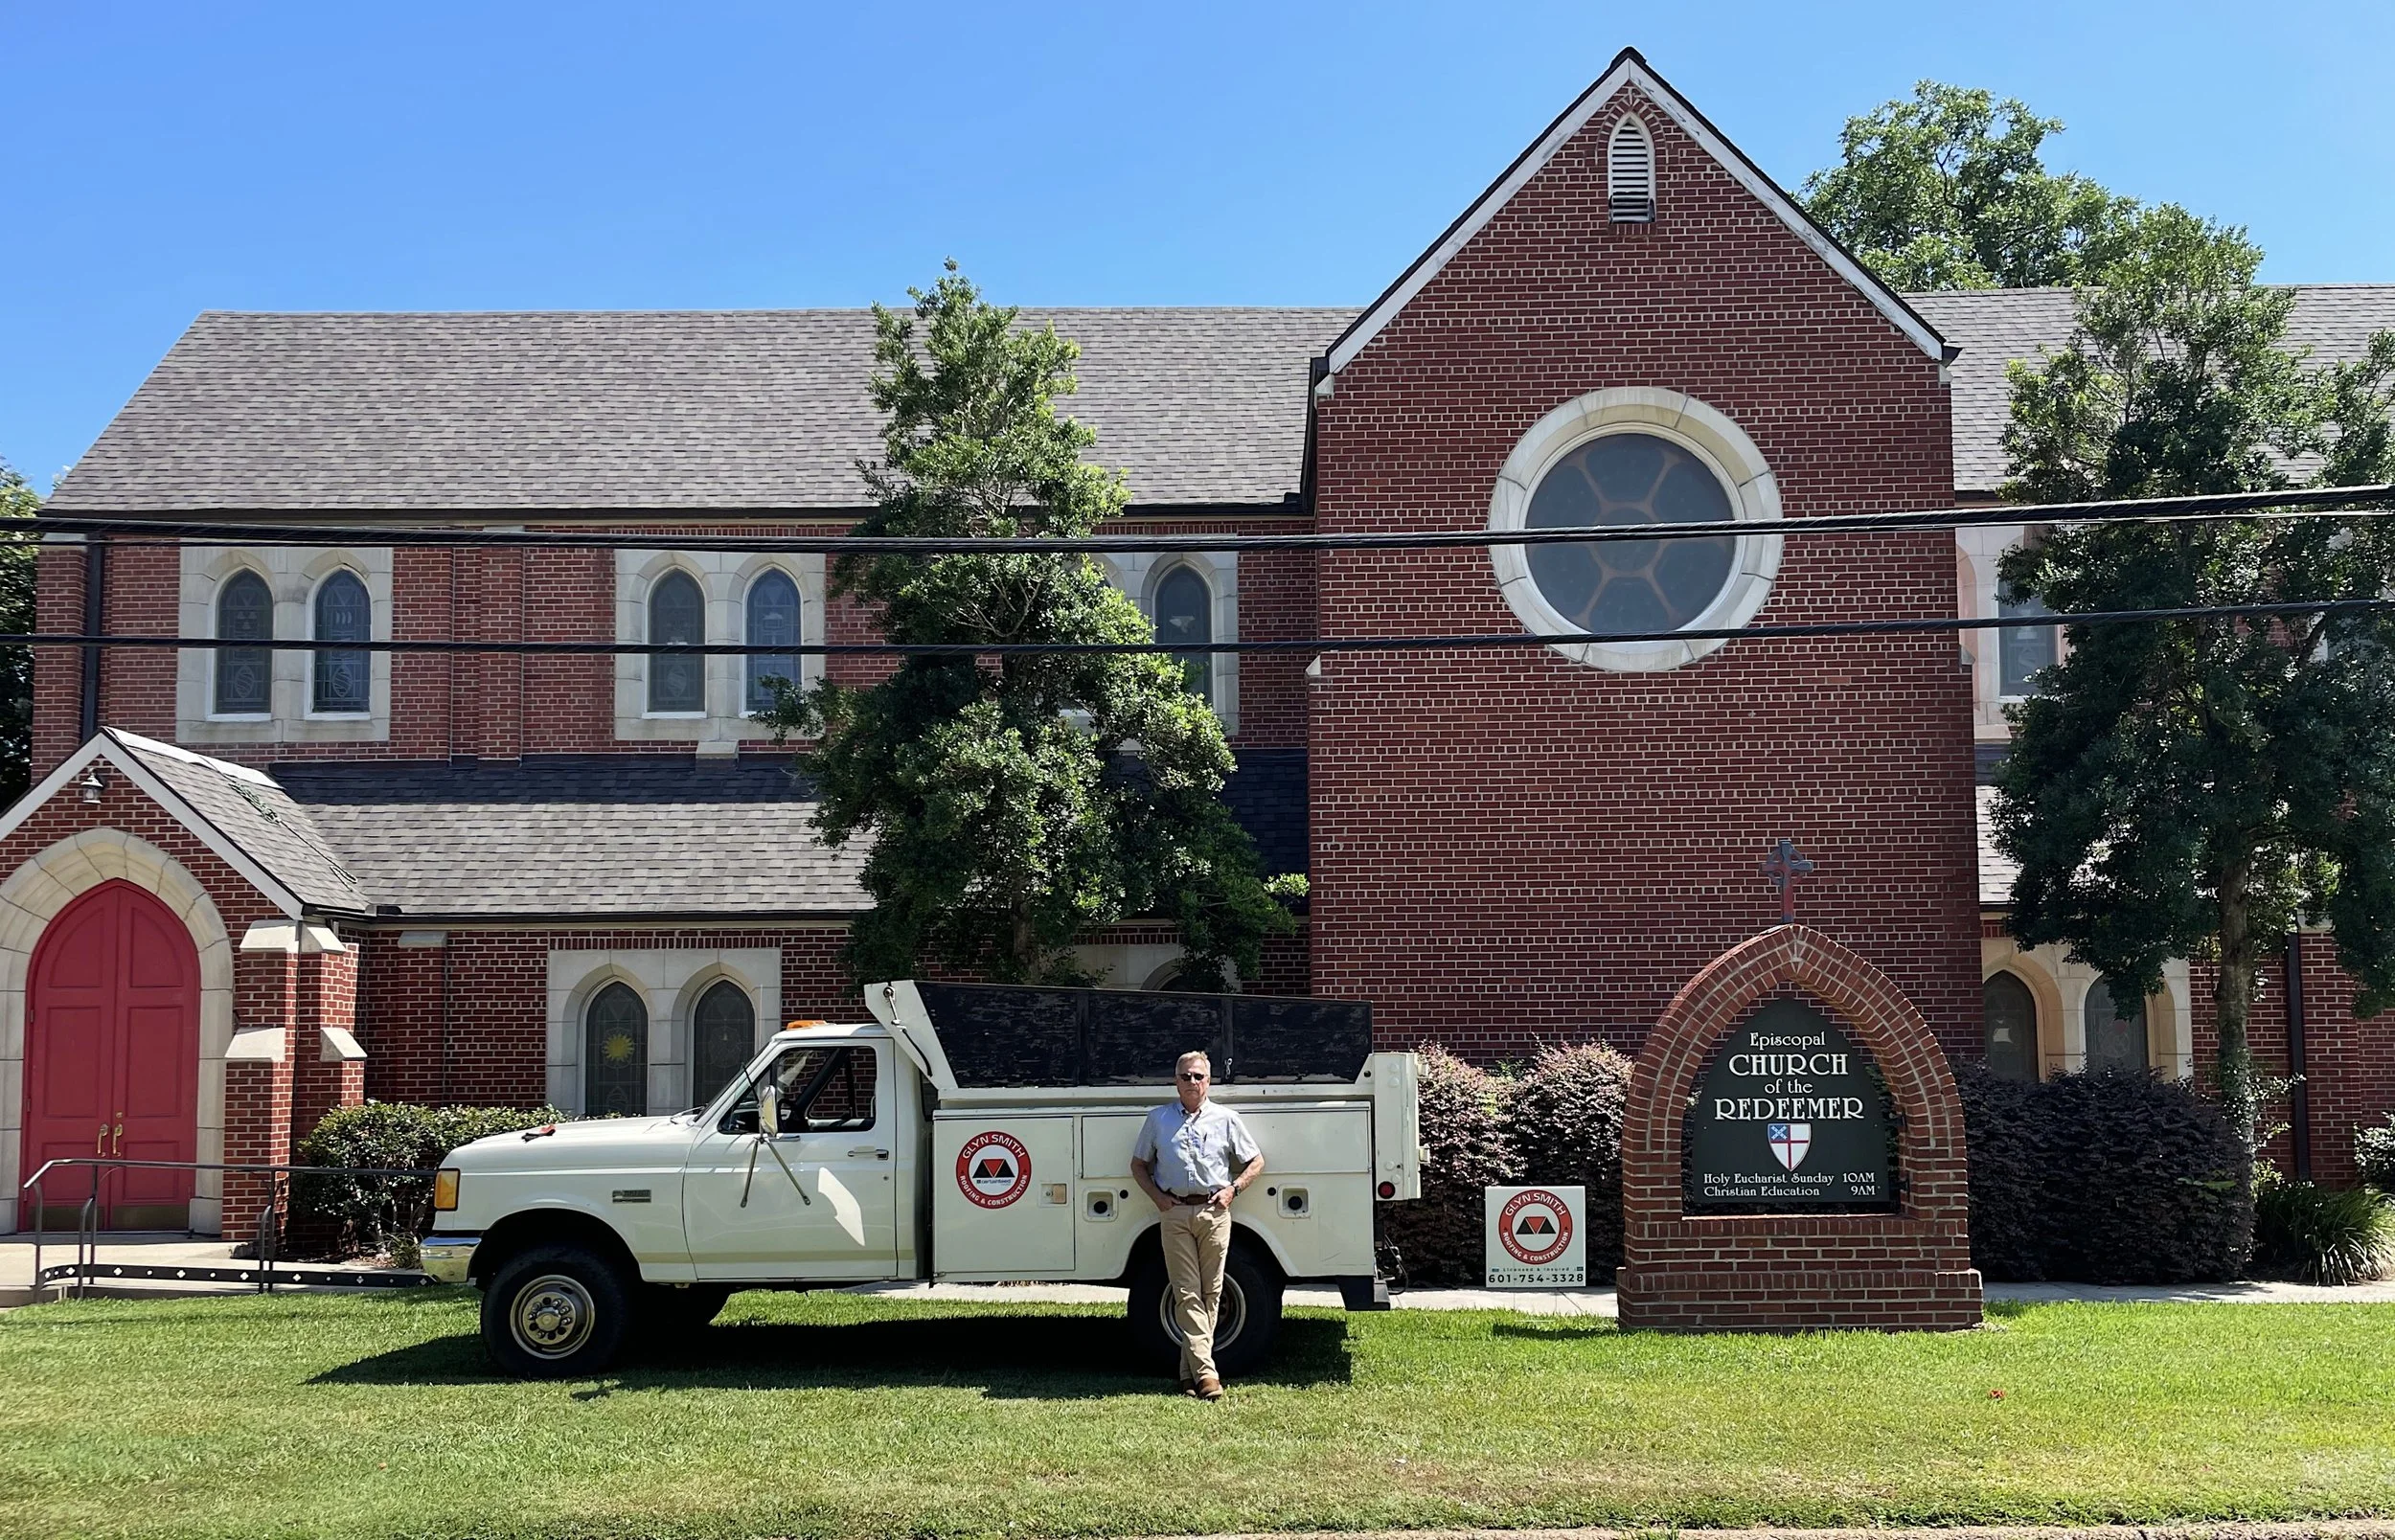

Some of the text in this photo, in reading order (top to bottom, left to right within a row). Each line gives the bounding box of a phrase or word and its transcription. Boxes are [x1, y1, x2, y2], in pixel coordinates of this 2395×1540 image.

[1749, 1031, 1825, 1050] Episcopal
[1728, 1053, 1848, 1076] CHURCH
[1764, 1078, 1813, 1094] of the
[1714, 1098, 1864, 1121] REDEEMER
[962, 1134, 1025, 1159] GLYN SMITH
[959, 1175, 979, 1201] ROOFING
[987, 1174, 1027, 1206] CONSTRUCTION
[1703, 1173, 1875, 1187] Holy Eucharist Sunday 10AM
[1703, 1186, 1876, 1197] Christian Education 9AM
[1505, 1192, 1566, 1216] GLYN SMITH
[1502, 1232, 1522, 1257] ROOFING
[1530, 1232, 1569, 1261] CONSTRUCTION
[1489, 1274, 1584, 1283] 601-754-3328
